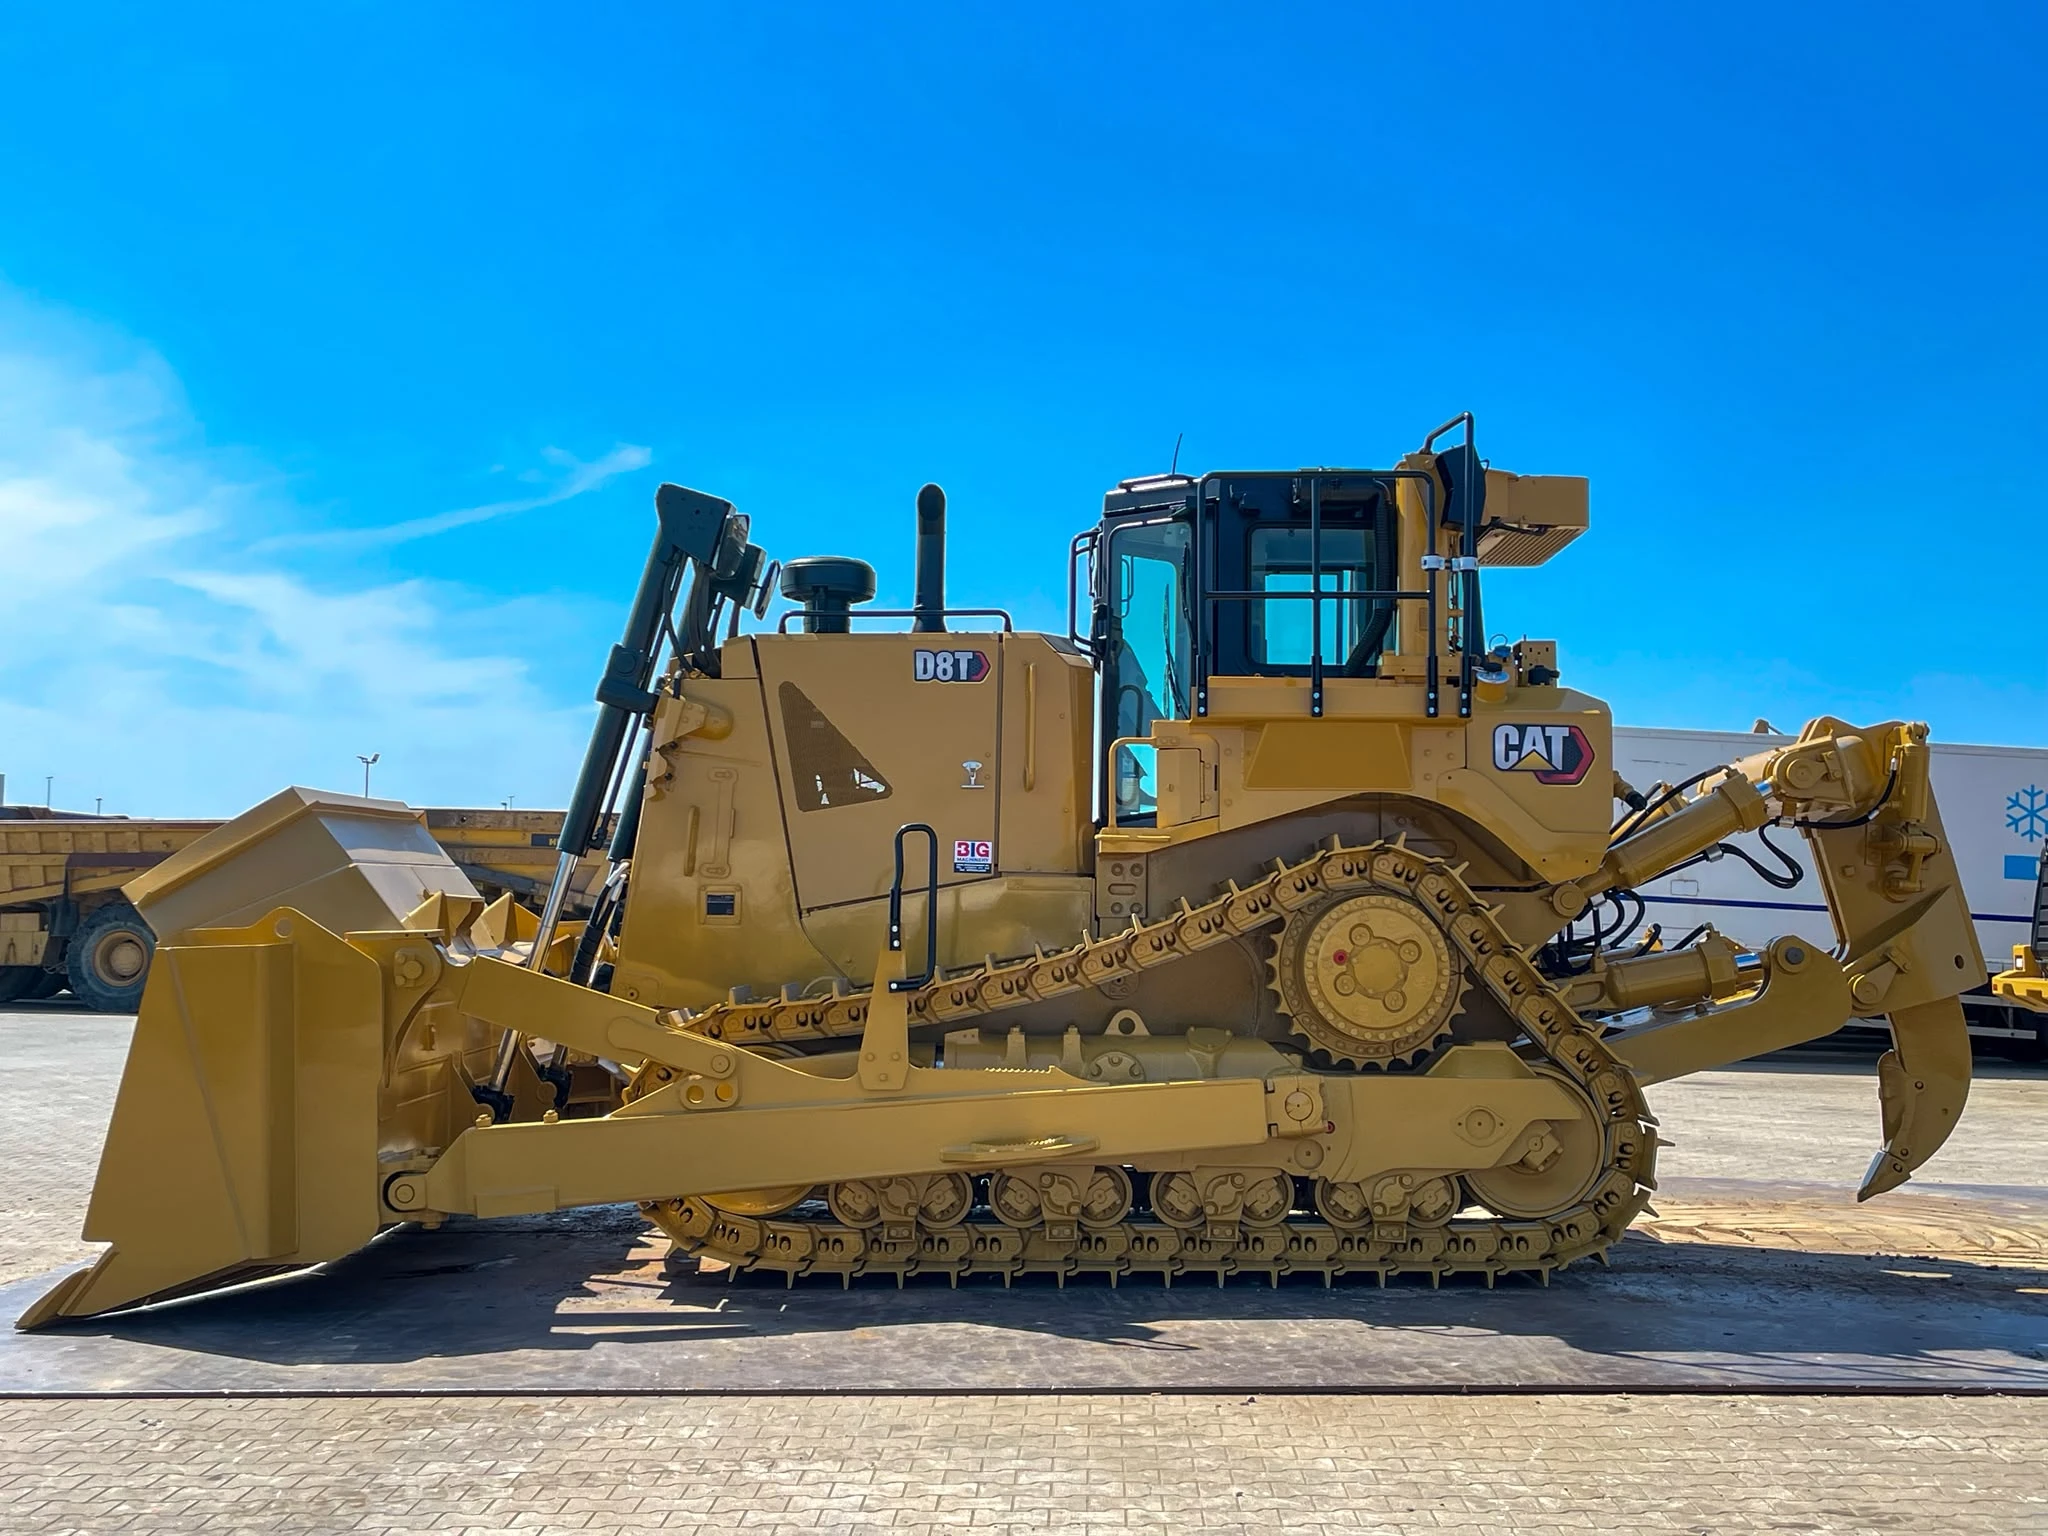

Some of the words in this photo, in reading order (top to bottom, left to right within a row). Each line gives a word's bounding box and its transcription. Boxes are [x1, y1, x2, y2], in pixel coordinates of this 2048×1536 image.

[915, 651, 973, 681] D8T
[1494, 725, 1570, 771] CAT
[957, 842, 989, 857] BIG
